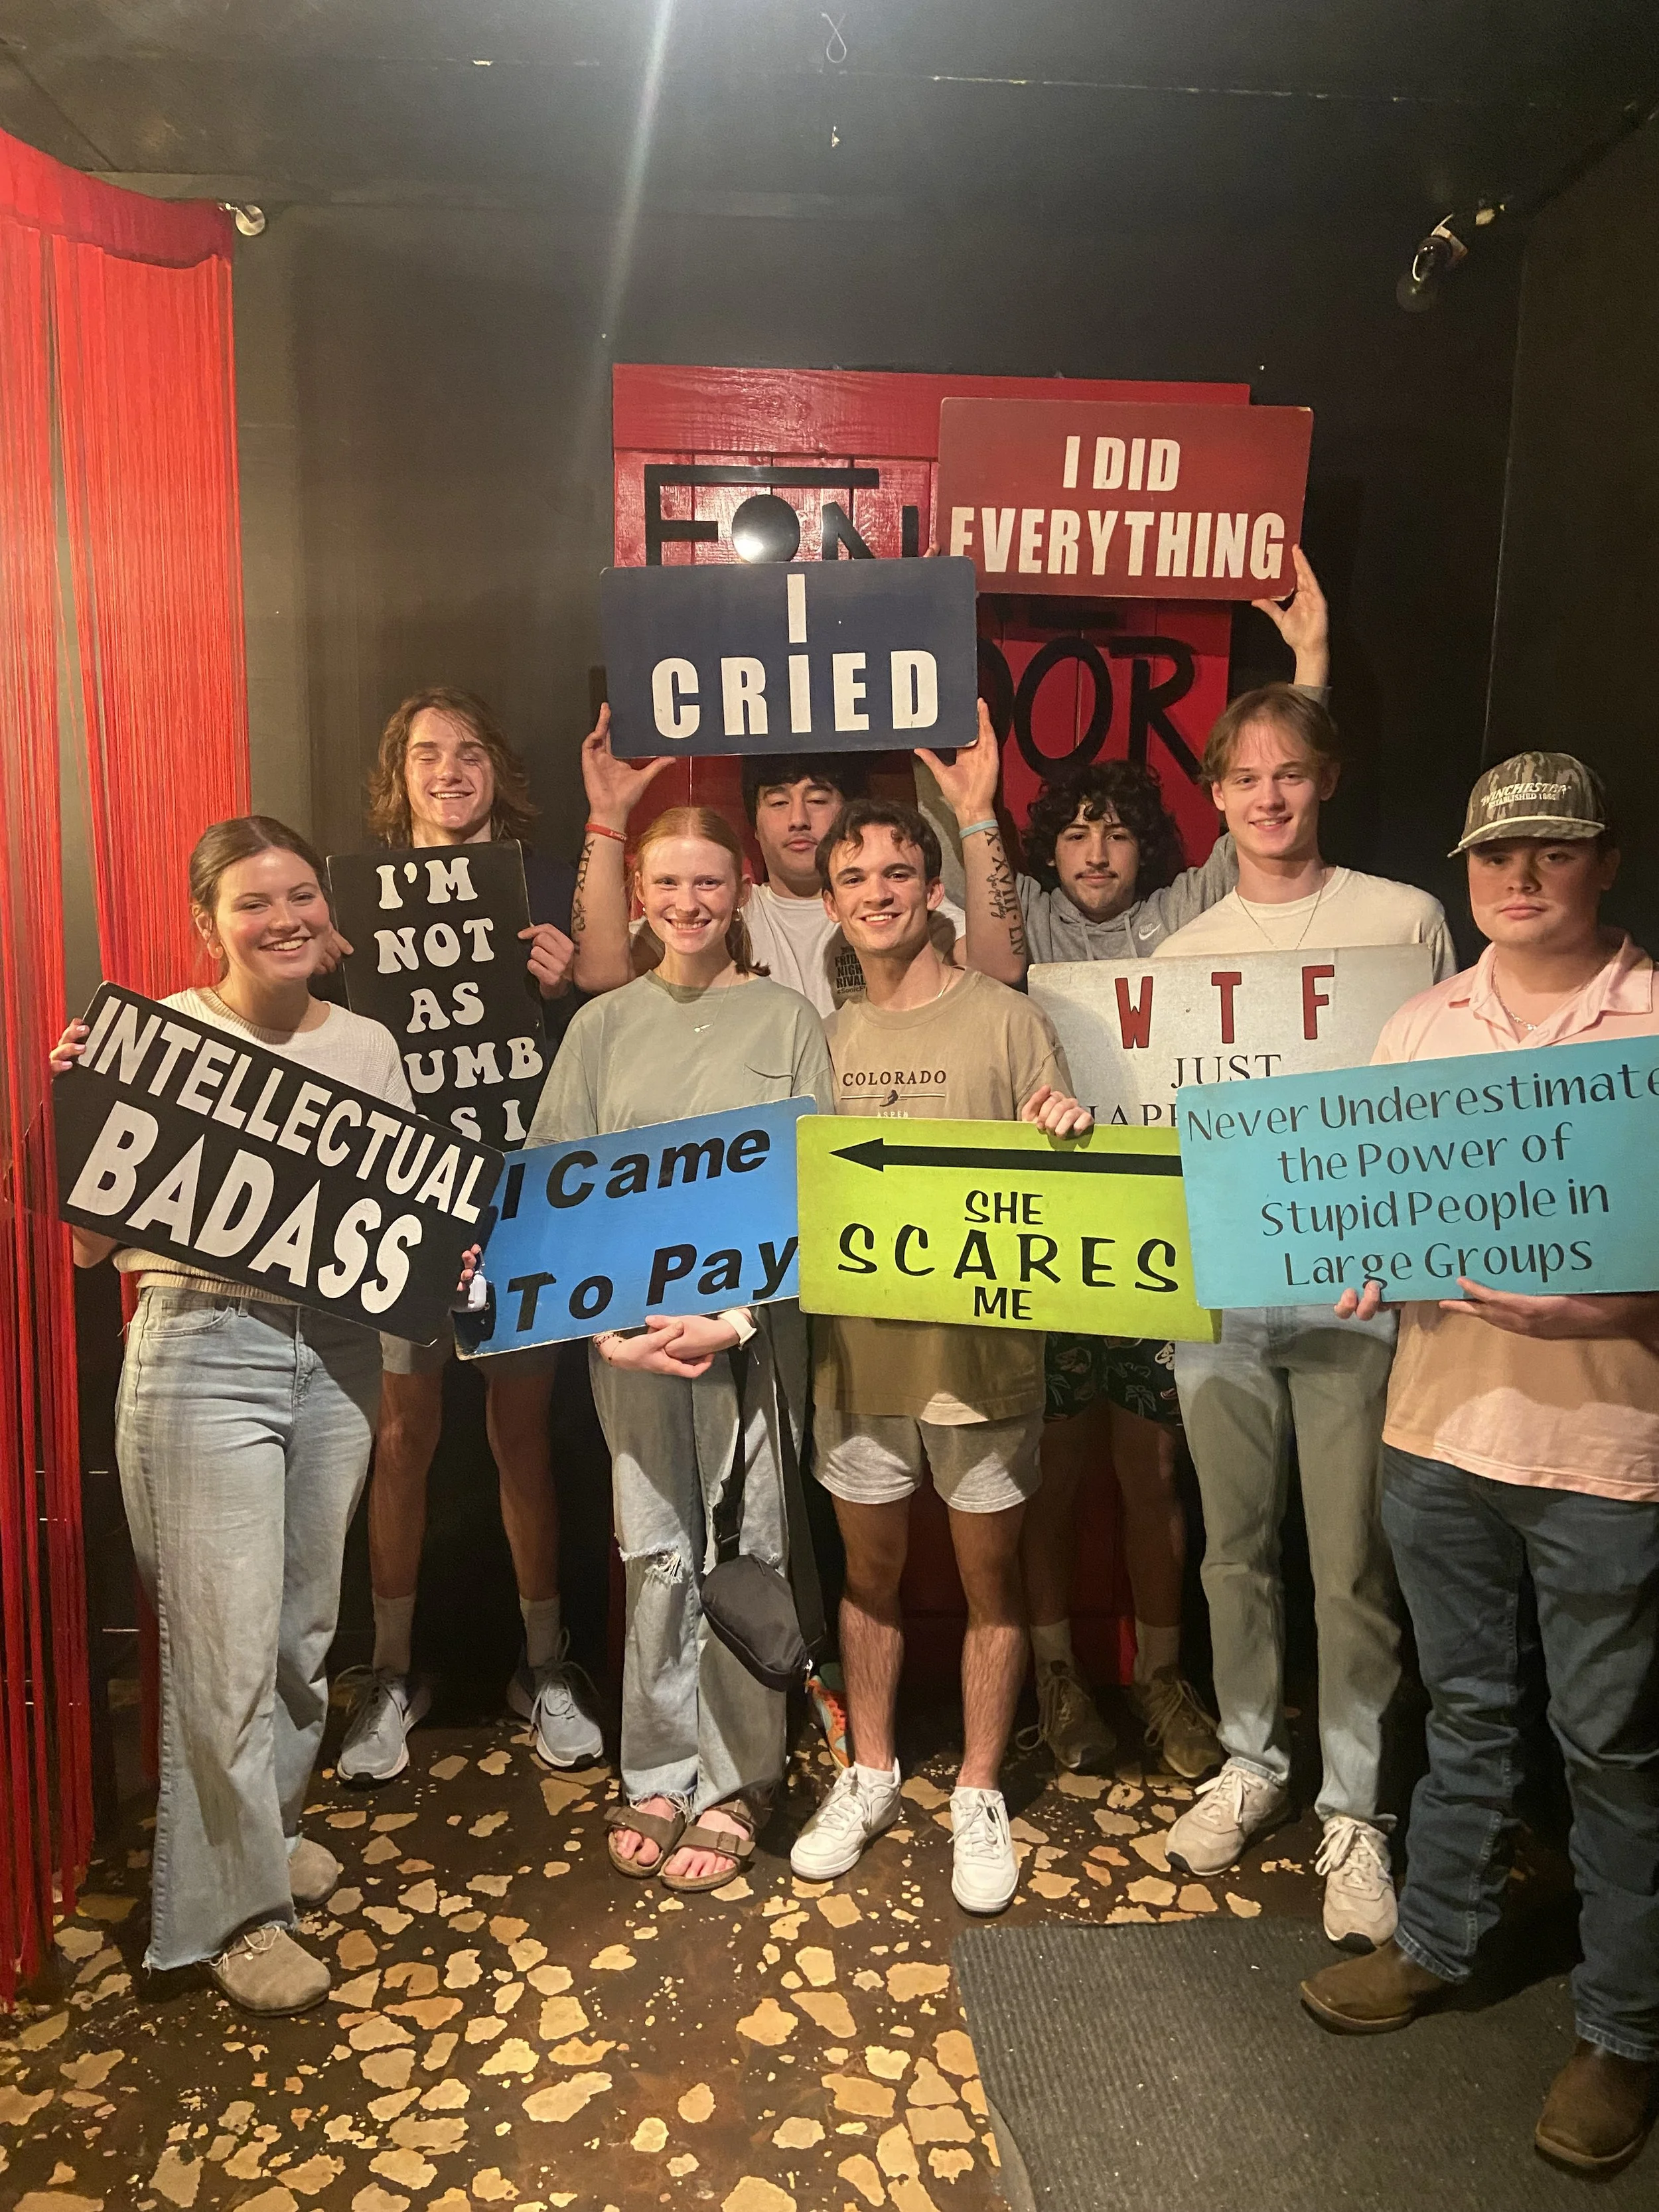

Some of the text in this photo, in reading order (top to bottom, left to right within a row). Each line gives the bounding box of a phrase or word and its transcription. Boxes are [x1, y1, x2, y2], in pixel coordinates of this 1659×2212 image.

[1063, 435, 1180, 492] I DID
[950, 506, 1285, 579] EVERYTHING
[787, 574, 807, 642] I
[652, 650, 938, 739] CRIED
[1480, 782, 1568, 807] WINCHESTER
[377, 857, 477, 910] I'M
[375, 918, 494, 974] NOT
[835, 954, 860, 967] FRID
[837, 964, 863, 977] NIGH
[406, 982, 484, 1033] AS
[404, 1037, 543, 1093] UMB
[842, 1070, 946, 1086] COLORADO
[1171, 1054, 1281, 1088] JUST
[79, 995, 485, 1224] INTELLECTUAL
[502, 1099, 527, 1142] I
[1187, 1101, 1308, 1143] Never
[501, 1129, 770, 1221] I Came
[1278, 1122, 1573, 1184] the Power of
[67, 1101, 423, 1315] BADASS
[965, 1191, 1043, 1224] SHE
[1260, 1179, 1609, 1240] Stupid People in
[507, 1235, 798, 1332] To Pay
[838, 1222, 1179, 1293] SCARES
[1283, 1238, 1593, 1291] Large Groups
[974, 1286, 1033, 1320] ME
